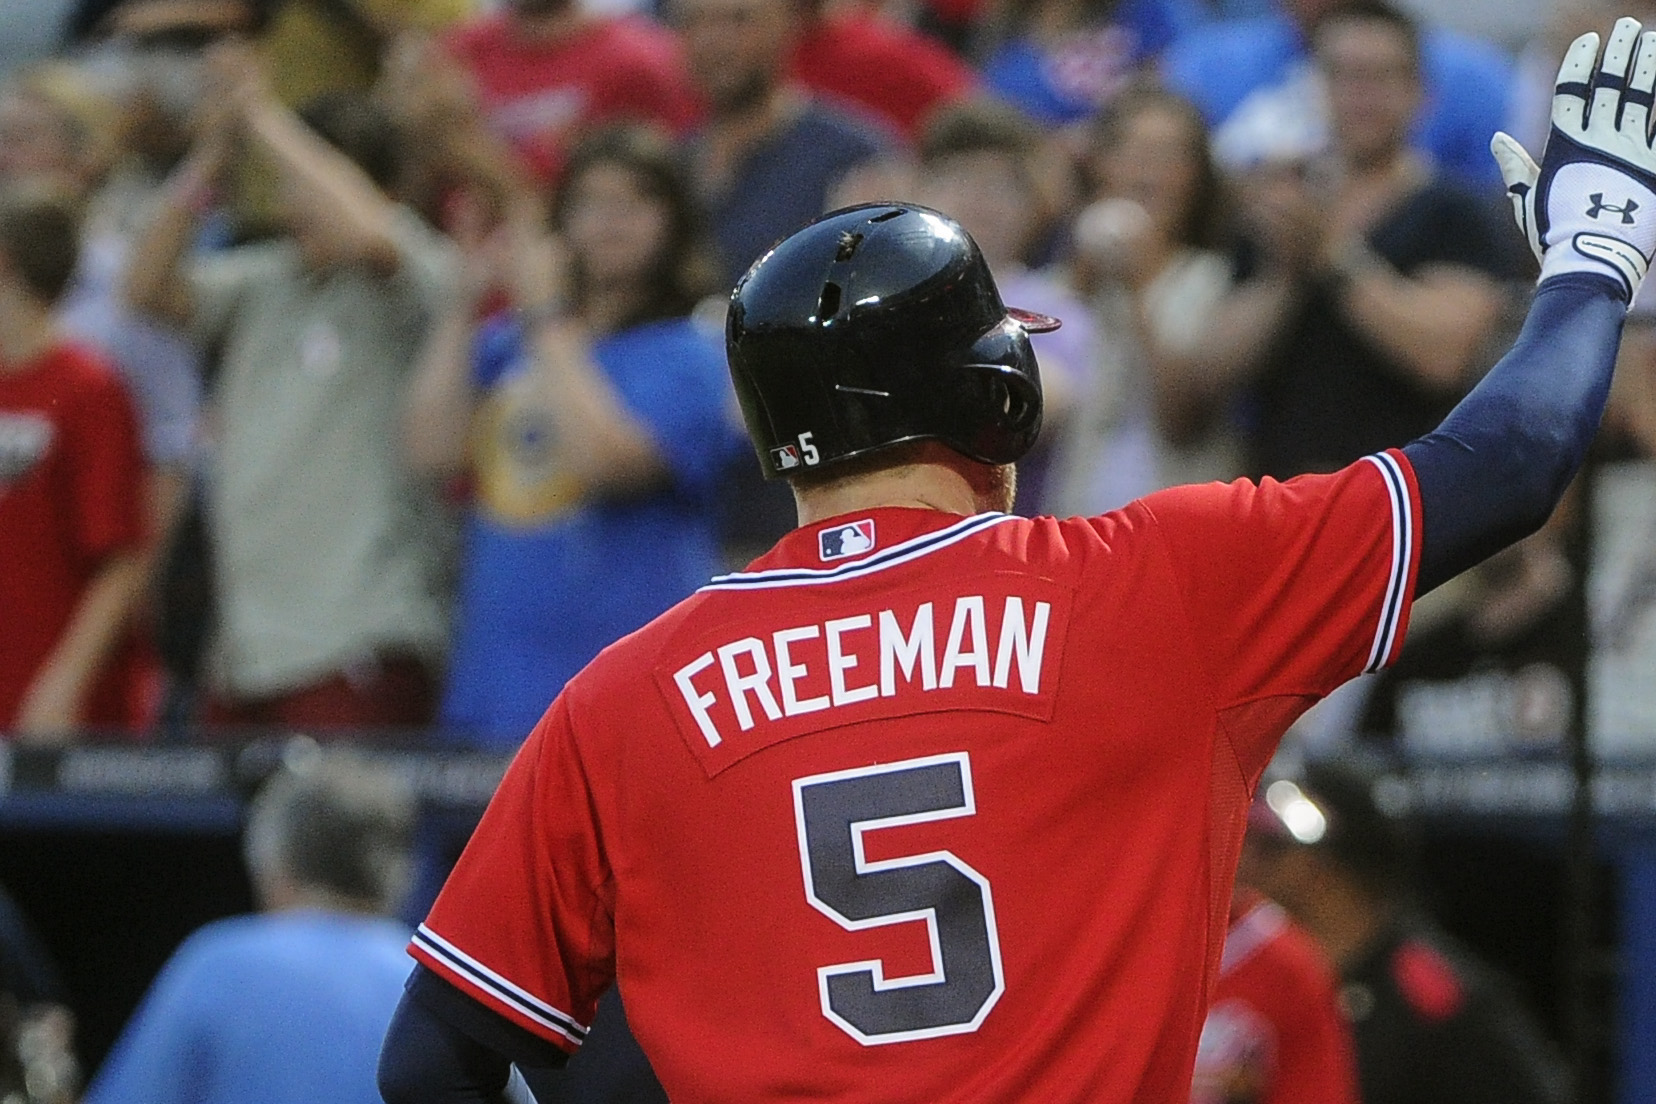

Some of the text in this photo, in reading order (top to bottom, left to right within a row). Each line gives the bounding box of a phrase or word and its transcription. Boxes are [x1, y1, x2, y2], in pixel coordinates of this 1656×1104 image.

[798, 431, 820, 466] 5
[673, 595, 1051, 748] FREEMAN
[791, 751, 1006, 1046] 5
